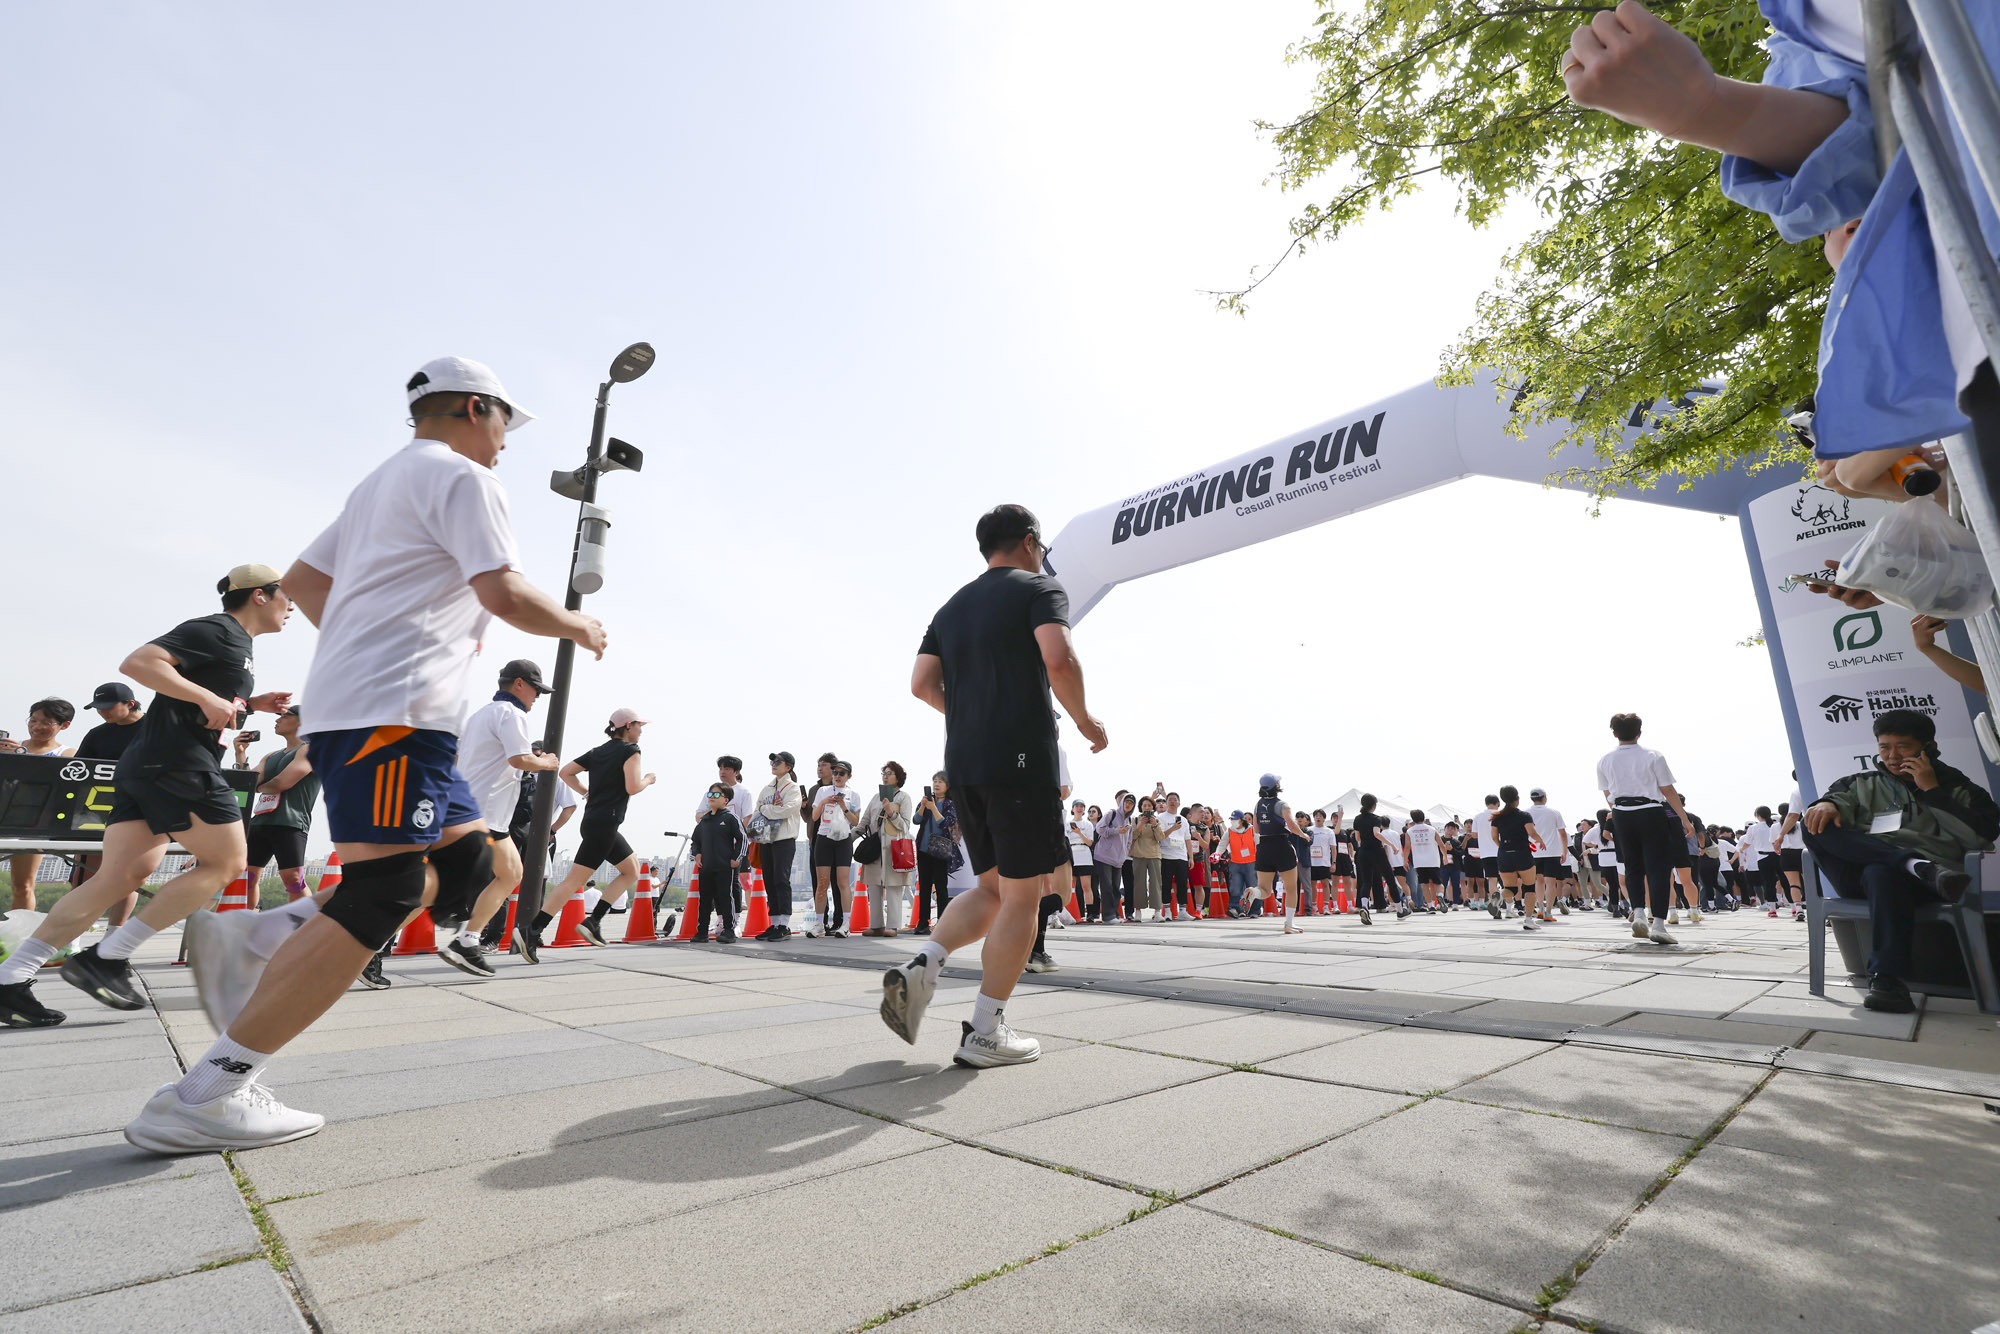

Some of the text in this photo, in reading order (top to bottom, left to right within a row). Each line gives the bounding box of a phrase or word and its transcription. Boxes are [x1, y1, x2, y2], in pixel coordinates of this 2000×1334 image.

[1112, 411, 1386, 545] BURNING RUN
[1235, 459, 1382, 517] Casual Running Festival
[1828, 652, 1904, 670] SLIMPLANET
[1866, 688, 1907, 697] 한국해비타트
[1868, 694, 1936, 710] Habitat
[970, 1035, 998, 1051] HOKA
